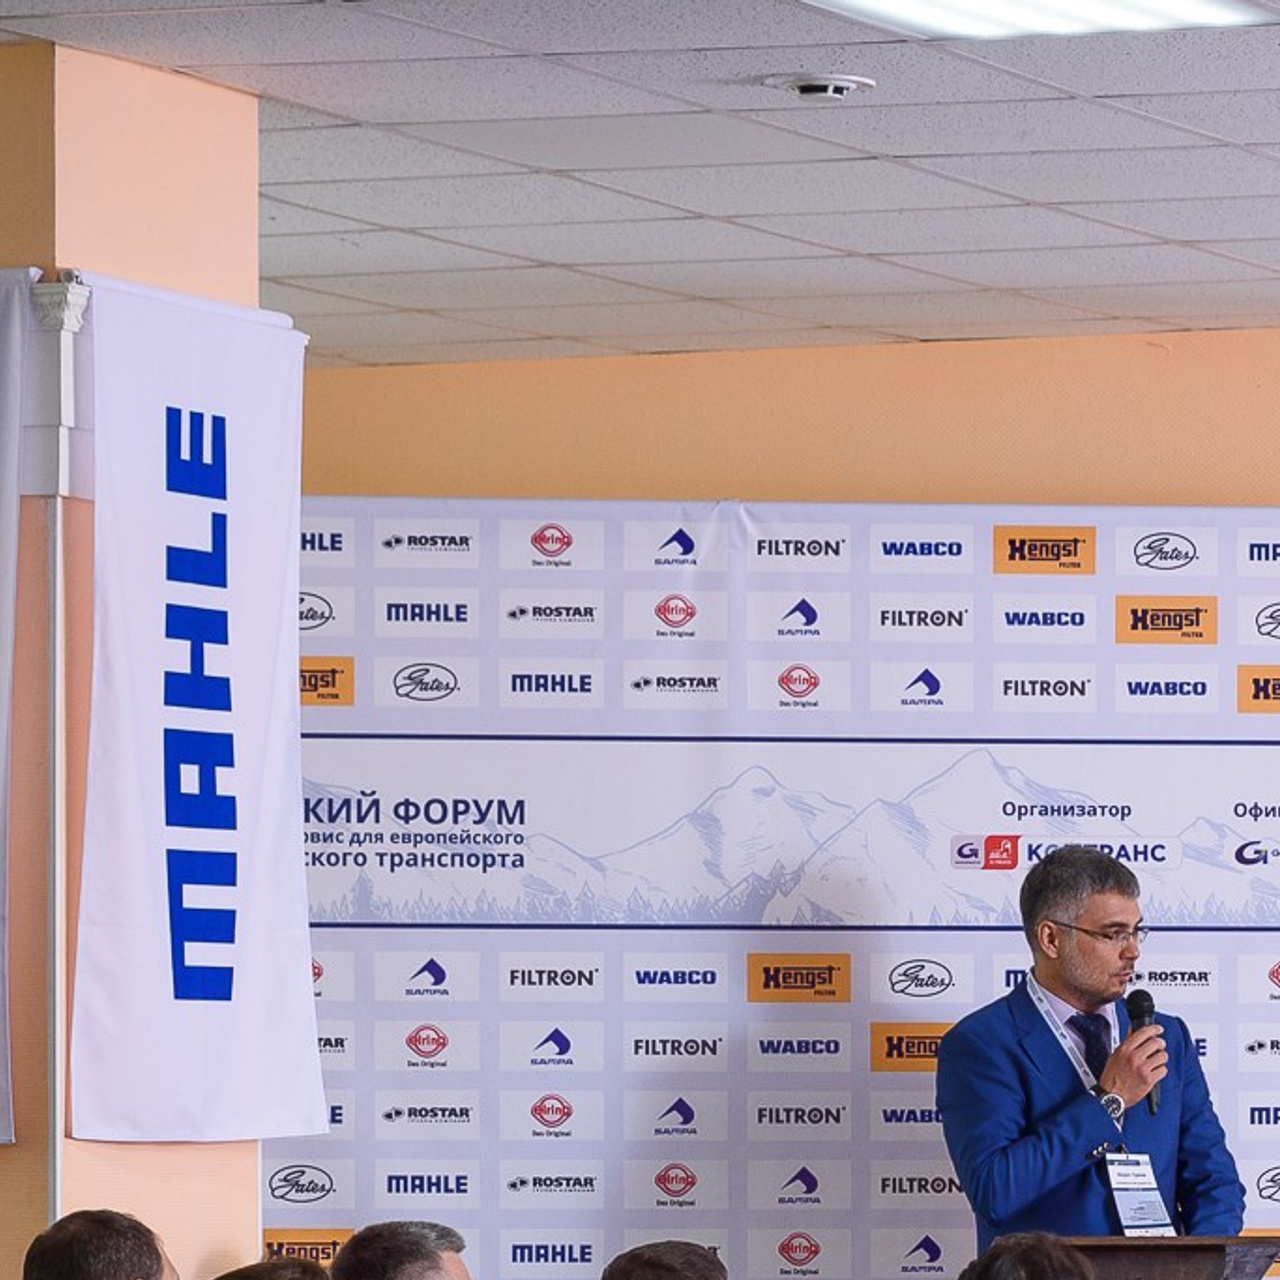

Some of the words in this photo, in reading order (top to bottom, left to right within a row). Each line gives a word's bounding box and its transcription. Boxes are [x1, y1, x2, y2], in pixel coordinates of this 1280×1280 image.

[301, 533, 342, 551] HLE
[407, 535, 471, 548] ROSTAR
[757, 539, 840, 556] FILTRON
[882, 542, 962, 556] WABCO
[1008, 538, 1079, 561] Hengst
[1139, 535, 1192, 567] Gates
[299, 598, 331, 620] ates
[387, 604, 467, 622] MAHLE
[532, 606, 594, 618] ROSTAR
[881, 610, 963, 627] FILTRON
[1005, 612, 1085, 626] WABCO
[1130, 608, 1201, 630] Hengst
[300, 669, 337, 690] ngst
[400, 667, 453, 699] Gates
[512, 675, 591, 692] MAHLE
[656, 677, 718, 689] ROSTAR
[1004, 681, 1086, 696] FILTRON
[1127, 682, 1207, 696] WABCO
[165, 405, 237, 1000] MAHLE
[304, 790, 380, 824] КИЙ
[393, 798, 525, 825] ФОРУМ
[1003, 801, 1132, 821] Организатор
[349, 832, 384, 847] для
[390, 829, 525, 848] европейского
[305, 851, 368, 867] кого
[376, 851, 525, 873] транспорта
[1027, 843, 1167, 864] КРАНС
[510, 970, 593, 986] FILTRON
[636, 970, 716, 985] WABCO
[763, 966, 835, 989] Hengst
[893, 964, 946, 996] Gates
[1148, 971, 1209, 982] ROSTAR
[318, 1037, 345, 1048] TAR
[634, 1040, 717, 1056] FILTRON
[759, 1040, 839, 1054] WABCO
[886, 1036, 938, 1058] Heng
[408, 1107, 470, 1118] ROSTAR
[758, 1107, 841, 1124] FILTRON
[275, 1168, 329, 1199] Gates
[387, 1175, 468, 1193] MAHLE
[532, 1176, 594, 1188] ROSTAR
[511, 1244, 592, 1263] MAHLE
